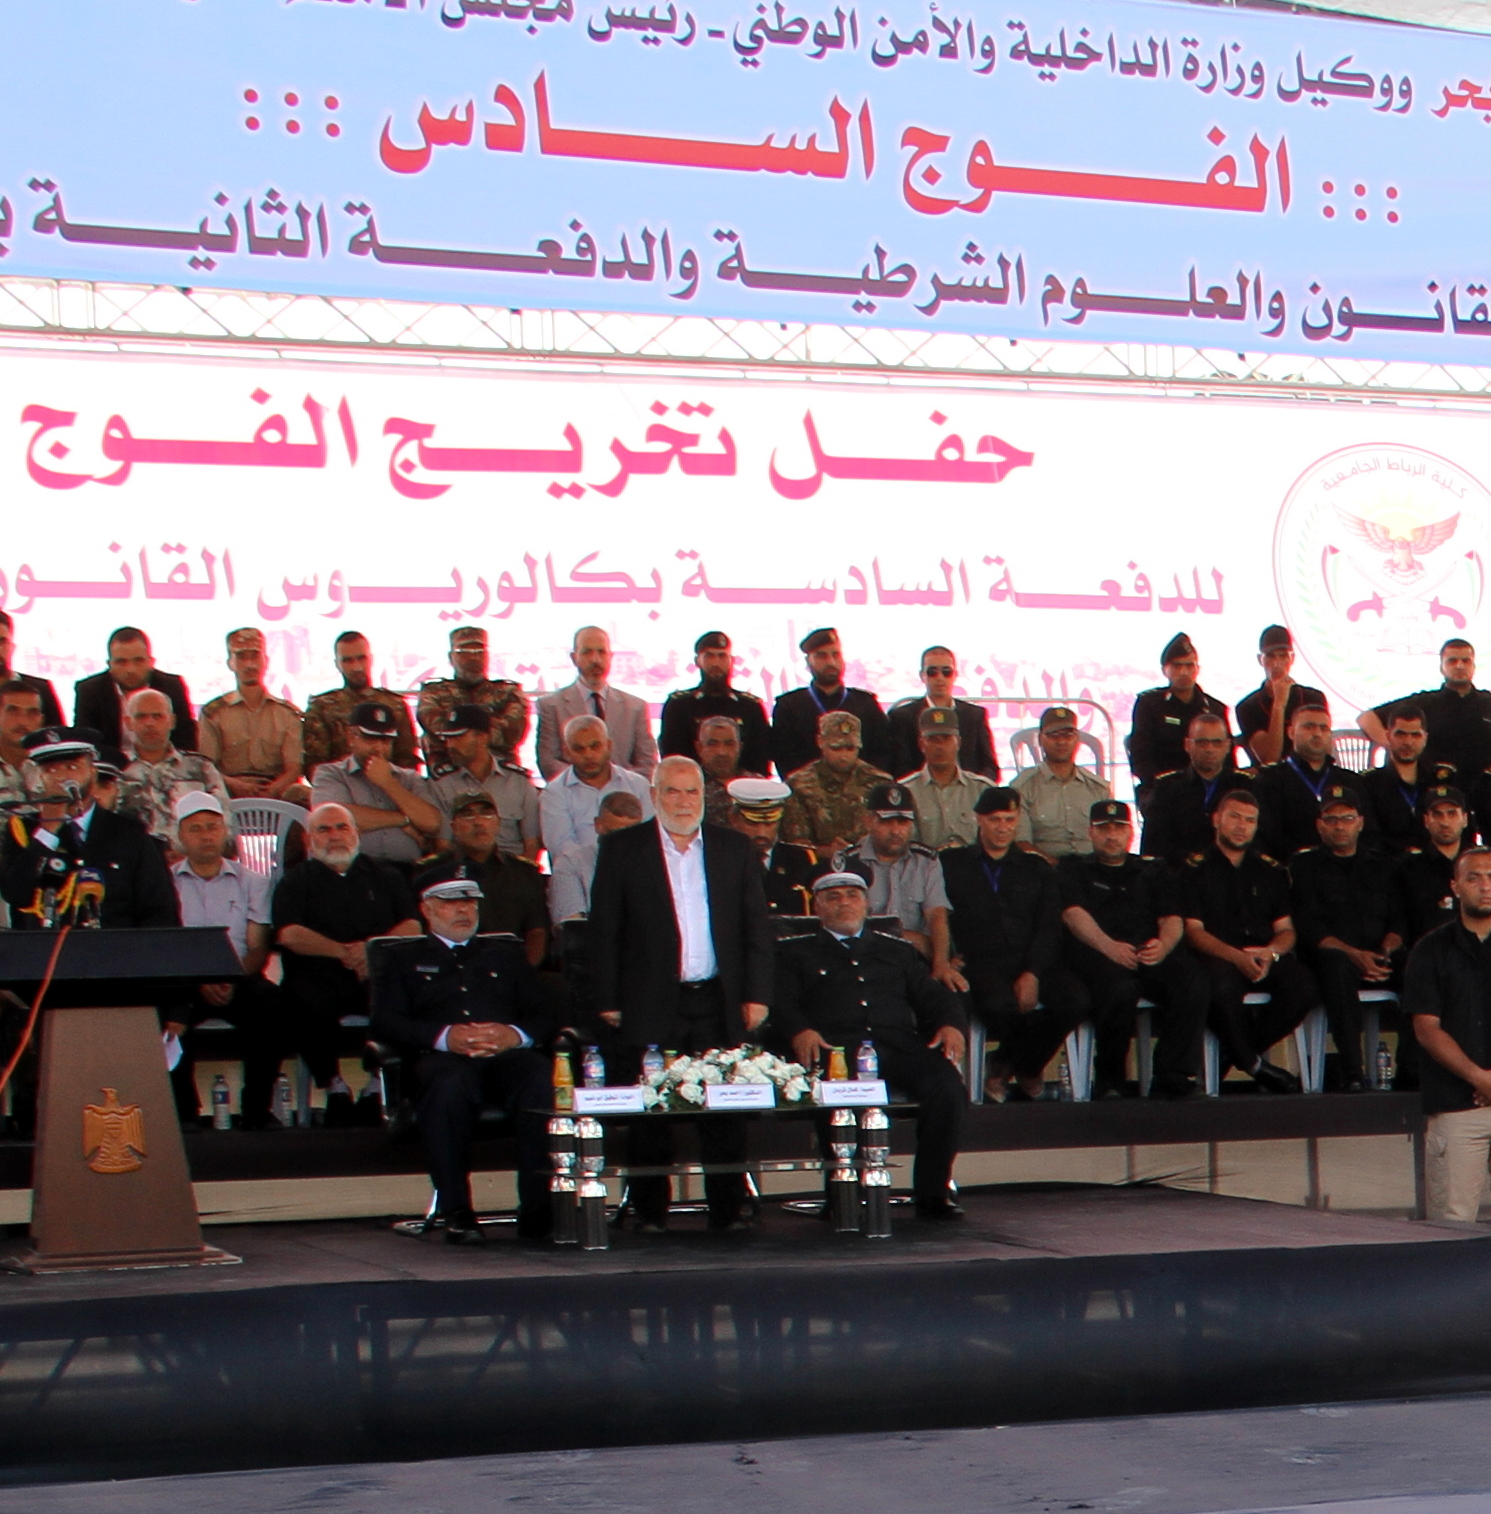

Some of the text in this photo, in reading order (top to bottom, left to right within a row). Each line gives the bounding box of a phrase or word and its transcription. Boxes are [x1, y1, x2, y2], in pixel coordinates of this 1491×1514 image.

[733, 0, 858, 68] الوطني
[871, 6, 996, 75] والأمن
[1006, 21, 1171, 82] الداخلية
[1181, 38, 1265, 100] وزارة
[1277, 52, 1413, 114] ووكيل
[379, 70, 875, 179] السادس
[900, 126, 1291, 216] الفوج
[28, 178, 329, 271] الثانية
[343, 201, 699, 300] والدفعة
[713, 229, 1026, 317] الشرطية
[1041, 267, 1286, 338] والعلوم
[19, 386, 1036, 501] حفل تخريج الفوج
[256, 550, 664, 622] بكالوريوس
[674, 548, 971, 608] السادسة
[981, 554, 1225, 615] للدفعة
